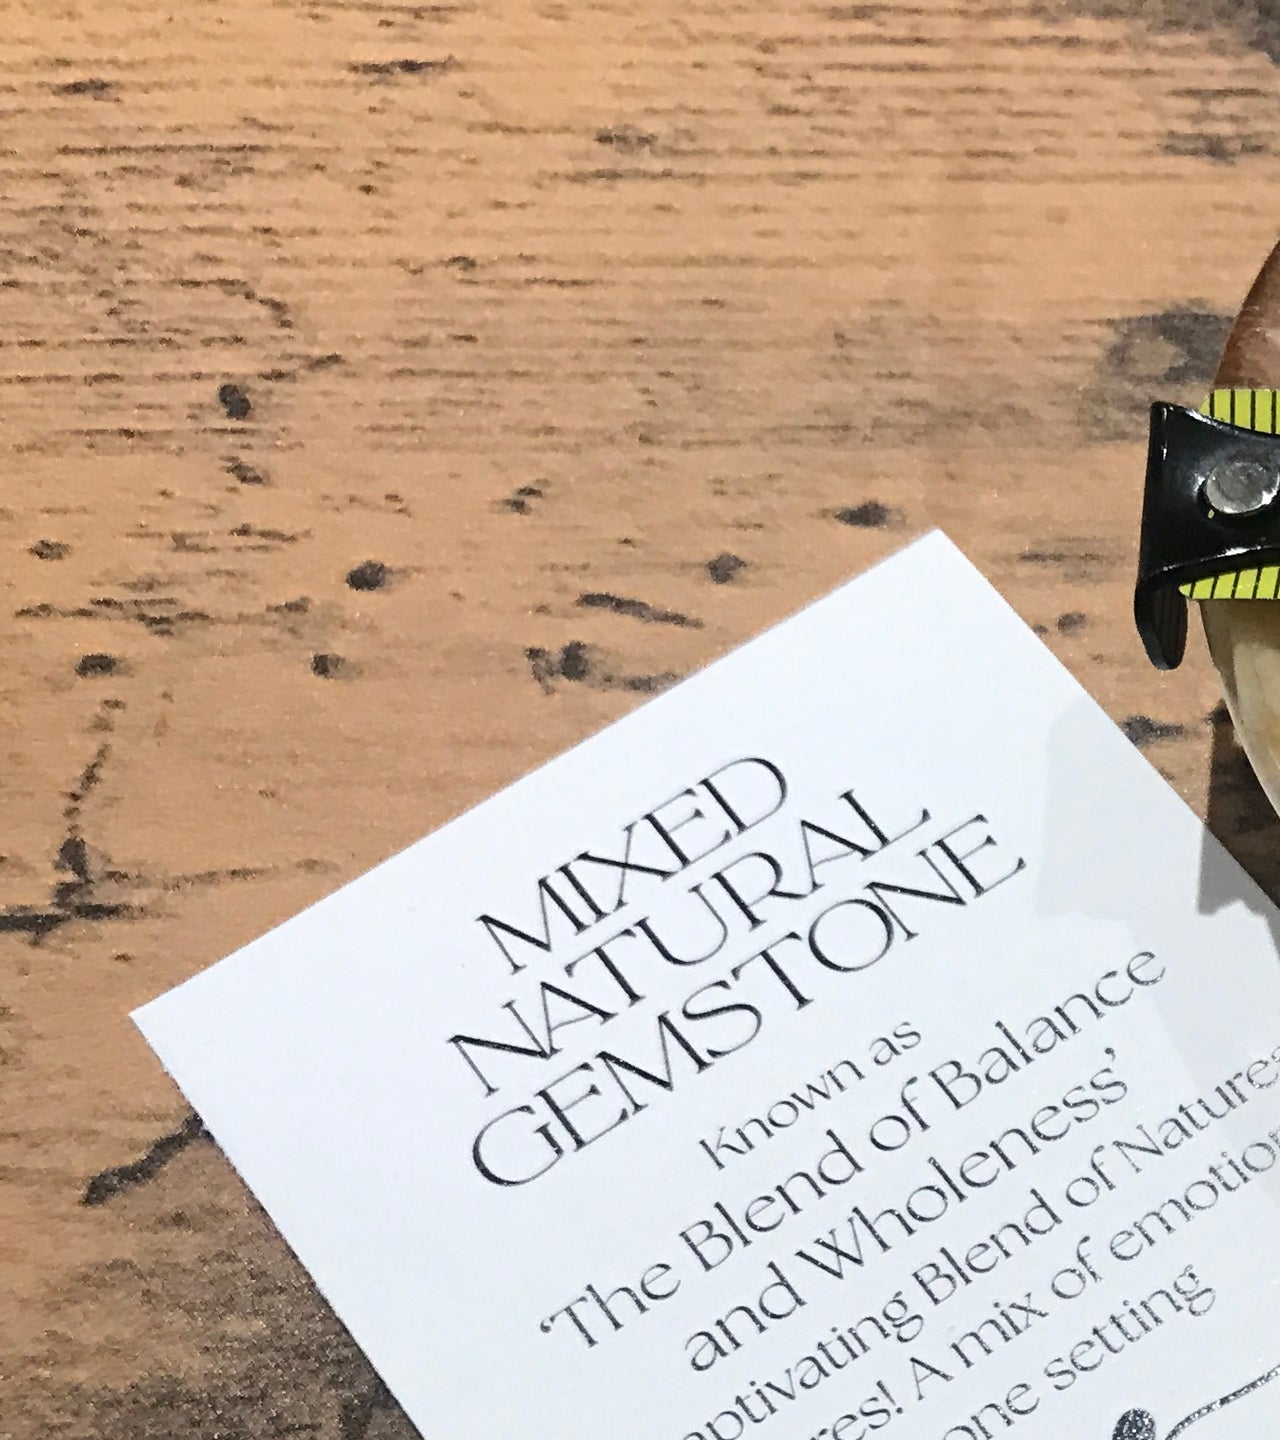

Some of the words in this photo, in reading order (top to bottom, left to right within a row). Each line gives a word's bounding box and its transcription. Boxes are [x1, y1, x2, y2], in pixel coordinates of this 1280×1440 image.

[446, 789, 931, 1098] NATURAL
[475, 757, 788, 975] MIXED
[471, 814, 1026, 1187] GEMSTONE
[869, 1021, 921, 1066] as
[678, 1129, 865, 1272] Blend
[869, 1076, 931, 1151] of
[928, 951, 1165, 1110] Balance
[911, 1188, 1062, 1307] Blend
[1065, 1145, 1116, 1207] of
[685, 1261, 808, 1371] and
[907, 1356, 955, 1403] A
[949, 1292, 1049, 1369] mix
[1051, 1235, 1103, 1299] of
[1044, 1264, 1215, 1391] setting
